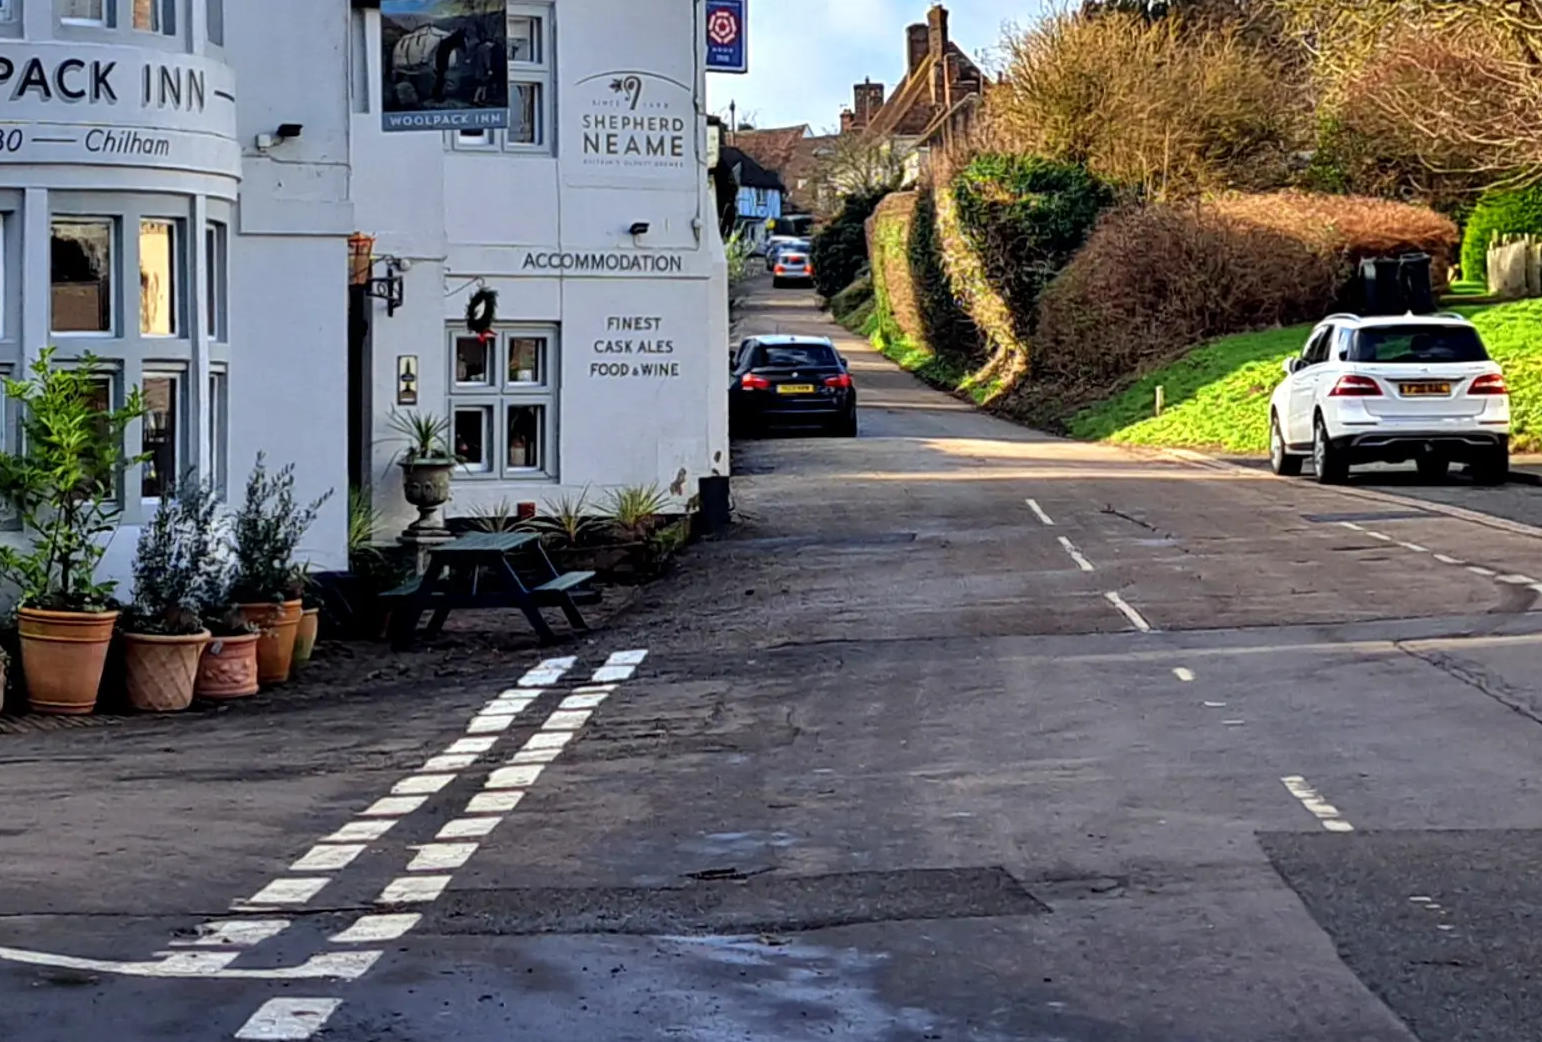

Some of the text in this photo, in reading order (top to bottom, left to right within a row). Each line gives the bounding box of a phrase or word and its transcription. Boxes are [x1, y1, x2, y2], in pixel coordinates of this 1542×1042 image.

[141, 63, 205, 113] INN
[390, 113, 500, 126] WOOLPACK INN
[582, 114, 684, 132] SHEPHERD
[85, 129, 169, 156] Chilham
[583, 132, 683, 157] NEAME
[522, 253, 682, 271] ACCOMMODATION
[607, 317, 662, 330] FINEST
[594, 340, 674, 354] CASK ALES
[590, 363, 679, 377] FOOD & WINE
